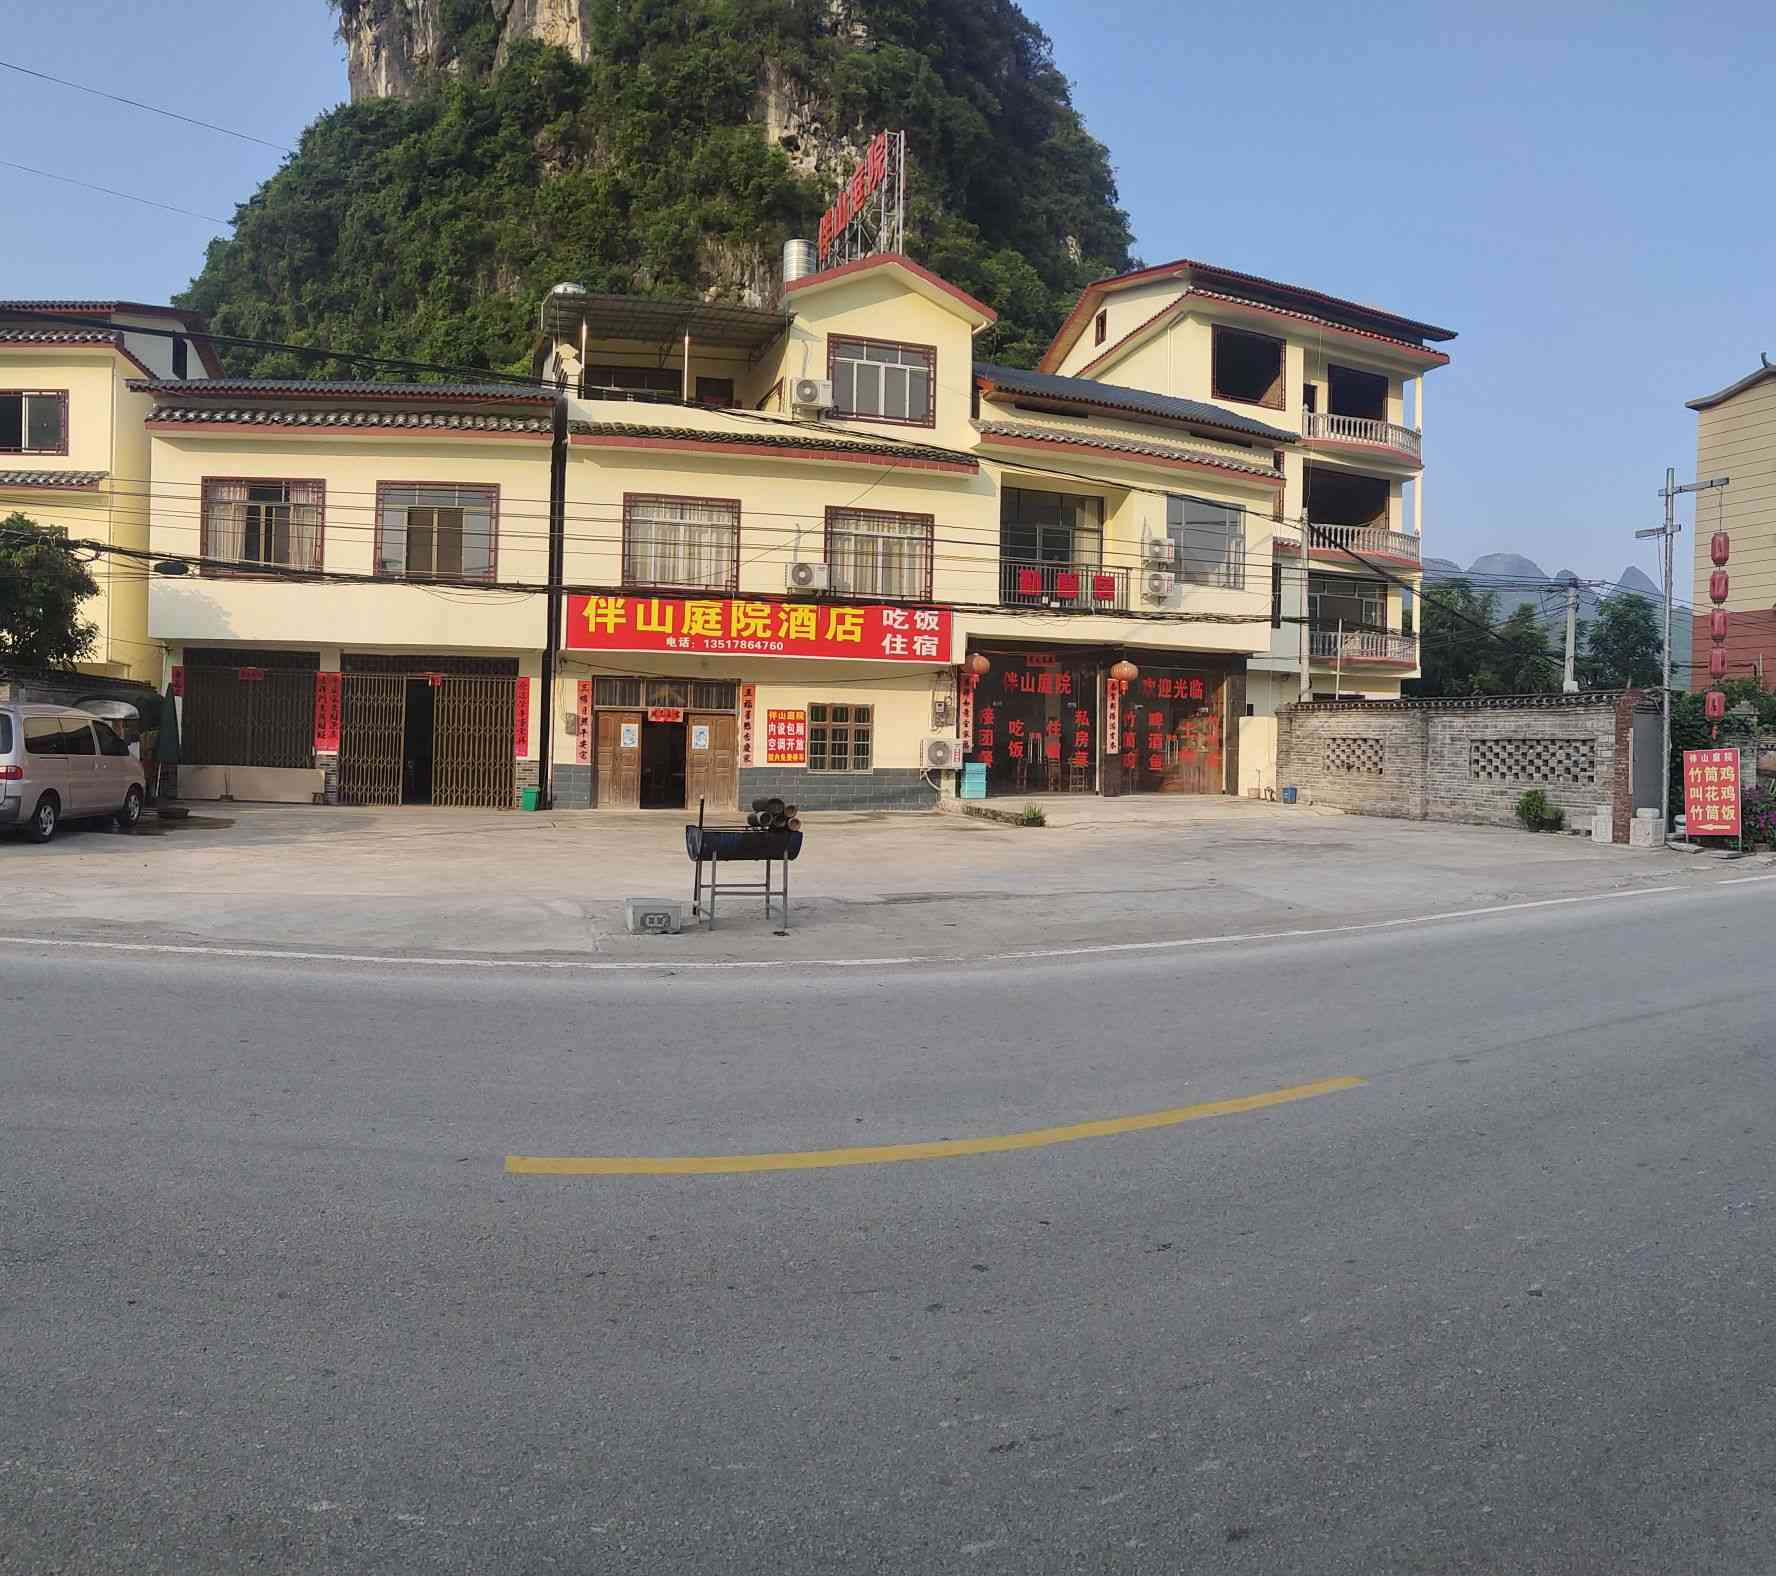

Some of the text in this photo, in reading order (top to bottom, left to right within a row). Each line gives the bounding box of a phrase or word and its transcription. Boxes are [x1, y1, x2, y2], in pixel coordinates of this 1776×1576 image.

[582, 596, 864, 642] 伴山庭院酒店
[881, 608, 939, 631] 吃饭
[704, 639, 783, 651] 13517864760
[881, 633, 939, 656] 住宿
[768, 738, 805, 751] 空调开放
[1008, 719, 1024, 759] 吃饭
[1688, 765, 1736, 783] 竹筒鸡
[1689, 785, 1736, 801] 叫花鸡
[1690, 804, 1736, 821] 竹筒饭
